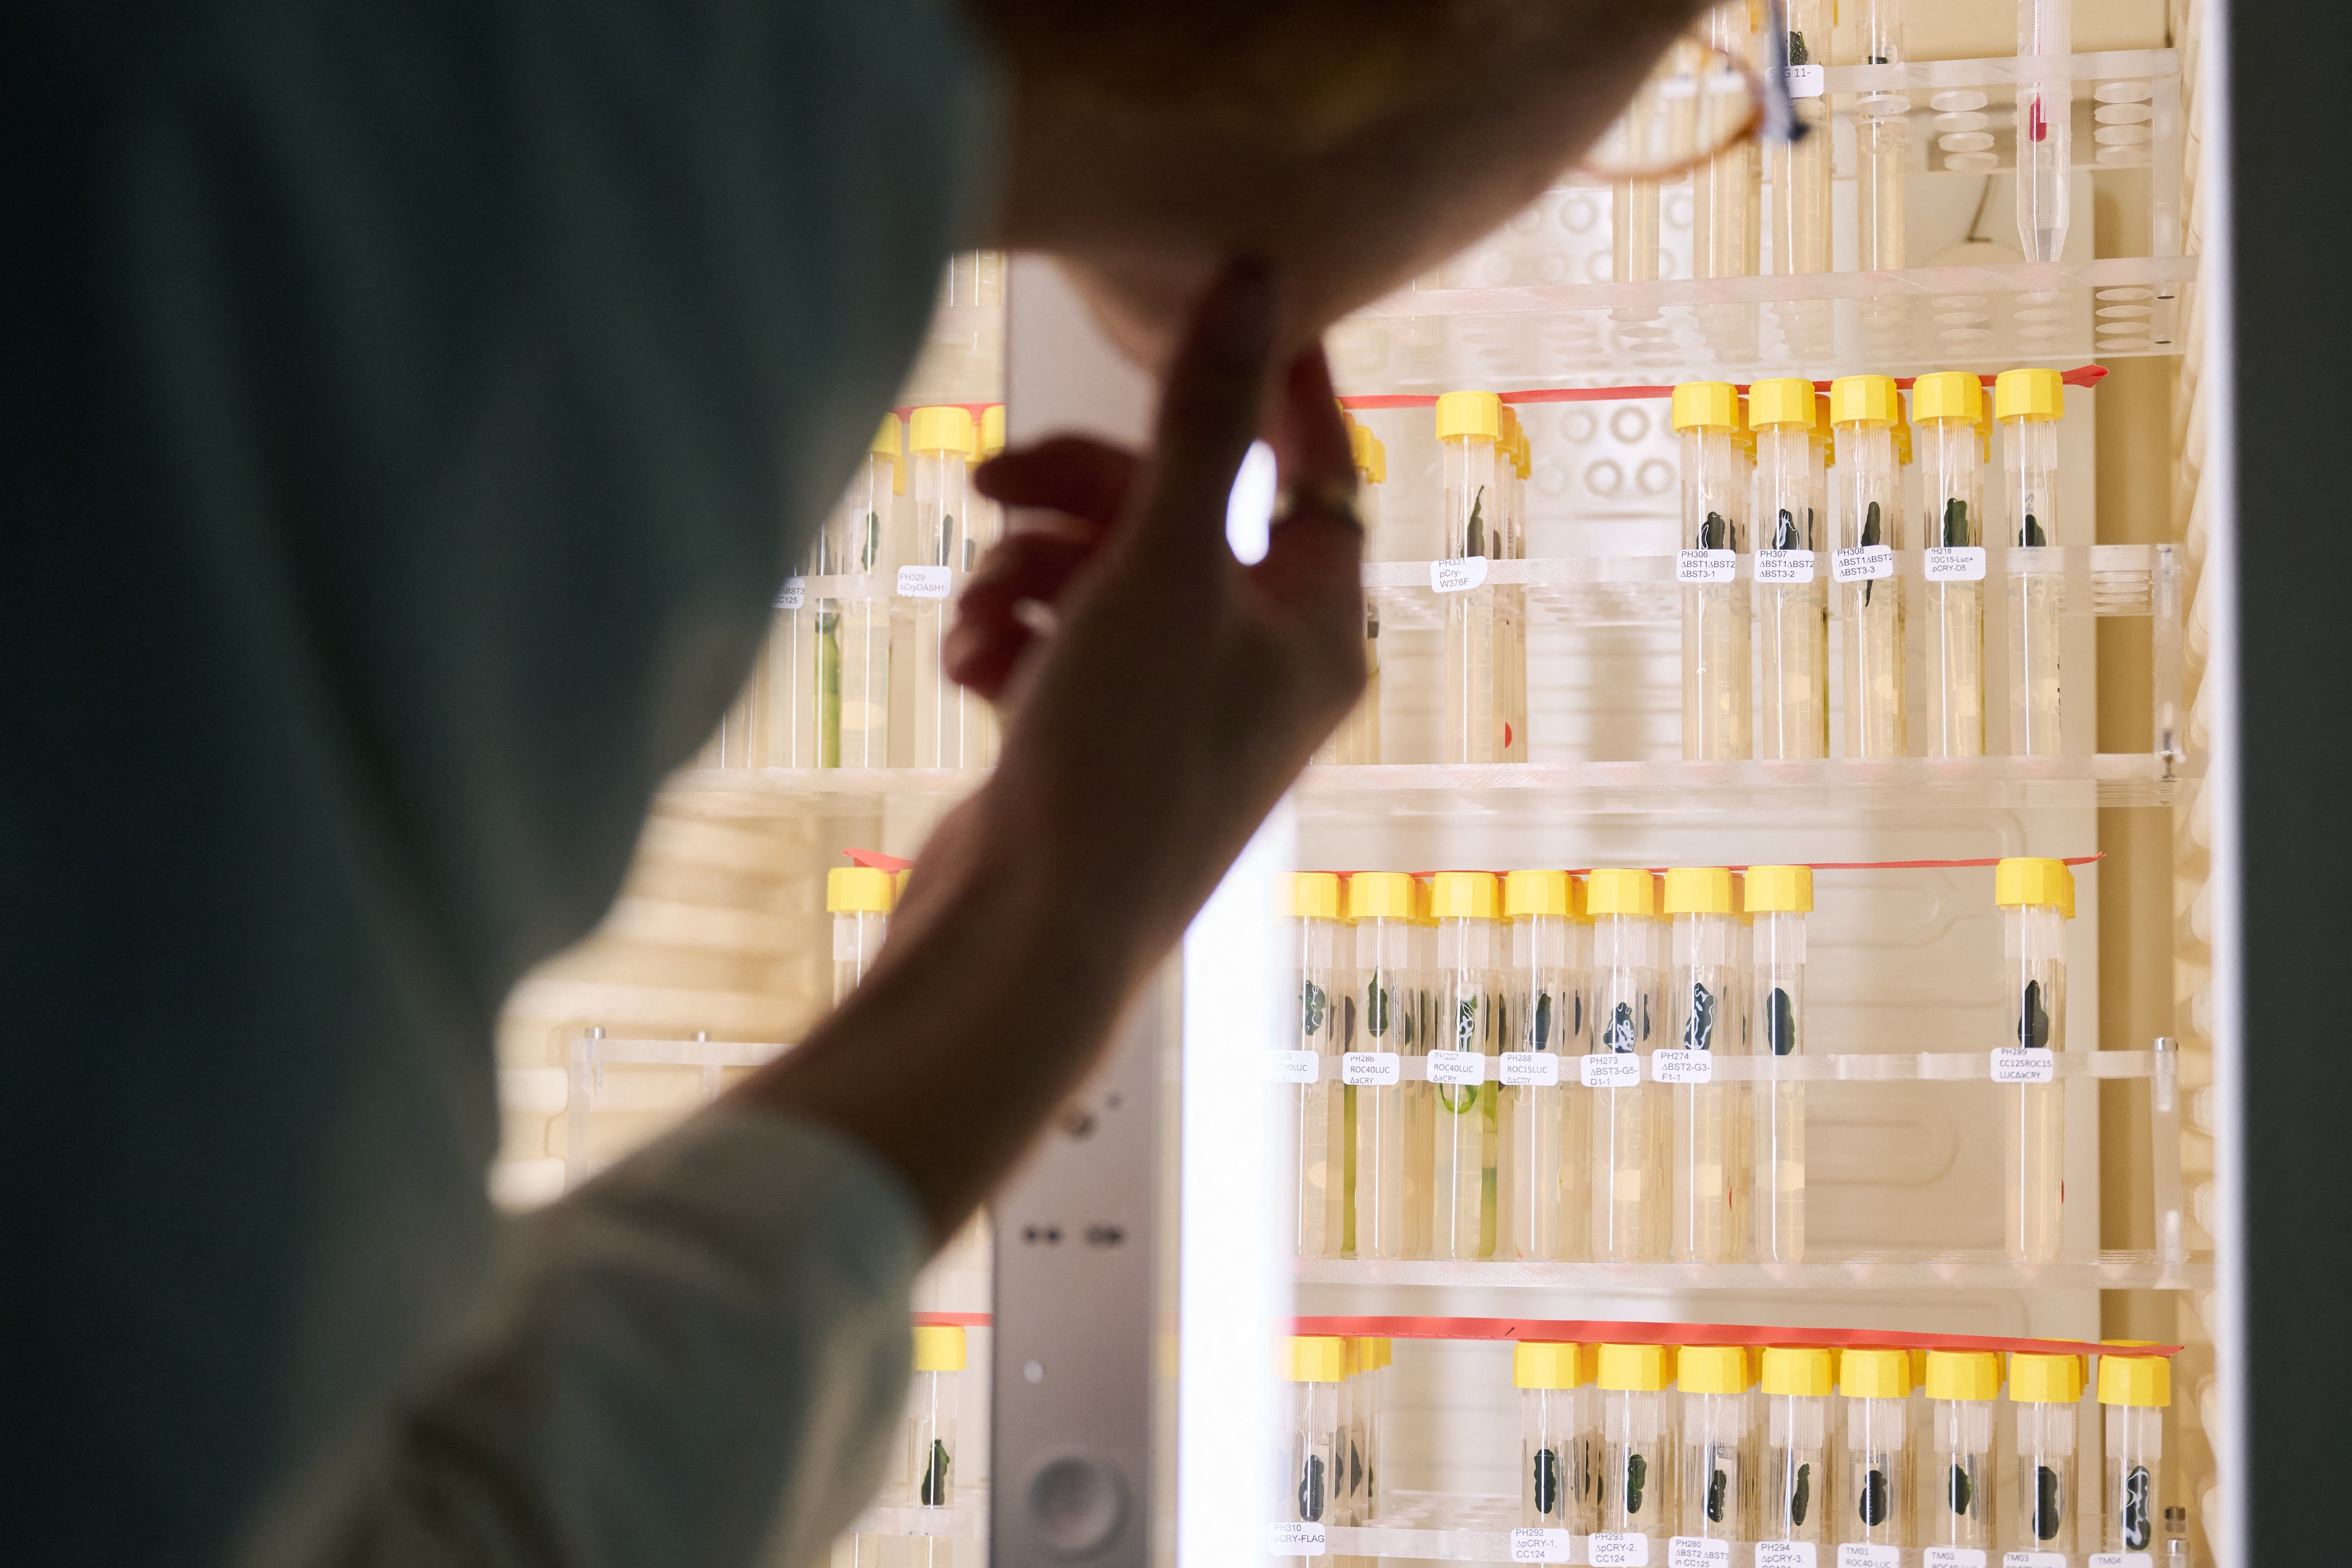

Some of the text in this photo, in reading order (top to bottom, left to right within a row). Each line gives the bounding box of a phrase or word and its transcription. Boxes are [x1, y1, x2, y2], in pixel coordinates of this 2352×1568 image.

[1770, 68, 1811, 78] SG 11-
[1681, 550, 1708, 558] PH306
[1760, 550, 1787, 558] PH307
[1837, 547, 1865, 557] PH308
[1439, 558, 1466, 567] PH331
[1839, 565, 1875, 577] ΔBST3-3
[1931, 565, 1966, 573] pCRY-D5
[899, 573, 926, 581] PH329
[1439, 569, 1461, 579] pCry-
[1680, 570, 1716, 578] ΔBST3-1
[1759, 570, 1795, 578] ΔBST3-2
[1440, 578, 1469, 587] W376F
[1508, 1054, 1532, 1062] PH288
[1589, 1057, 1618, 1065] PH273
[1272, 1064, 1308, 1072] OC40LUC
[1999, 1060, 2052, 1068] CC125ROC15
[1350, 1066, 1390, 1074] ROC40LUC
[1433, 1064, 1474, 1073] ROC40LUC
[1507, 1066, 1548, 1074] ROC15LUC
[1590, 1078, 1610, 1086] D1-1
[1274, 1524, 1302, 1532] PH310
[1516, 1528, 1545, 1536] PH292
[1274, 1534, 1325, 1543] pCRY-FLAG
[1675, 1539, 1701, 1549] PH280
[1761, 1543, 1790, 1551] PH294
[1516, 1550, 1545, 1559] CC124
[1846, 1547, 1869, 1556] TM01
[1595, 1555, 1625, 1563] CC124
[1931, 1551, 1954, 1561] TM02
[1683, 1559, 1710, 1568] CC125
